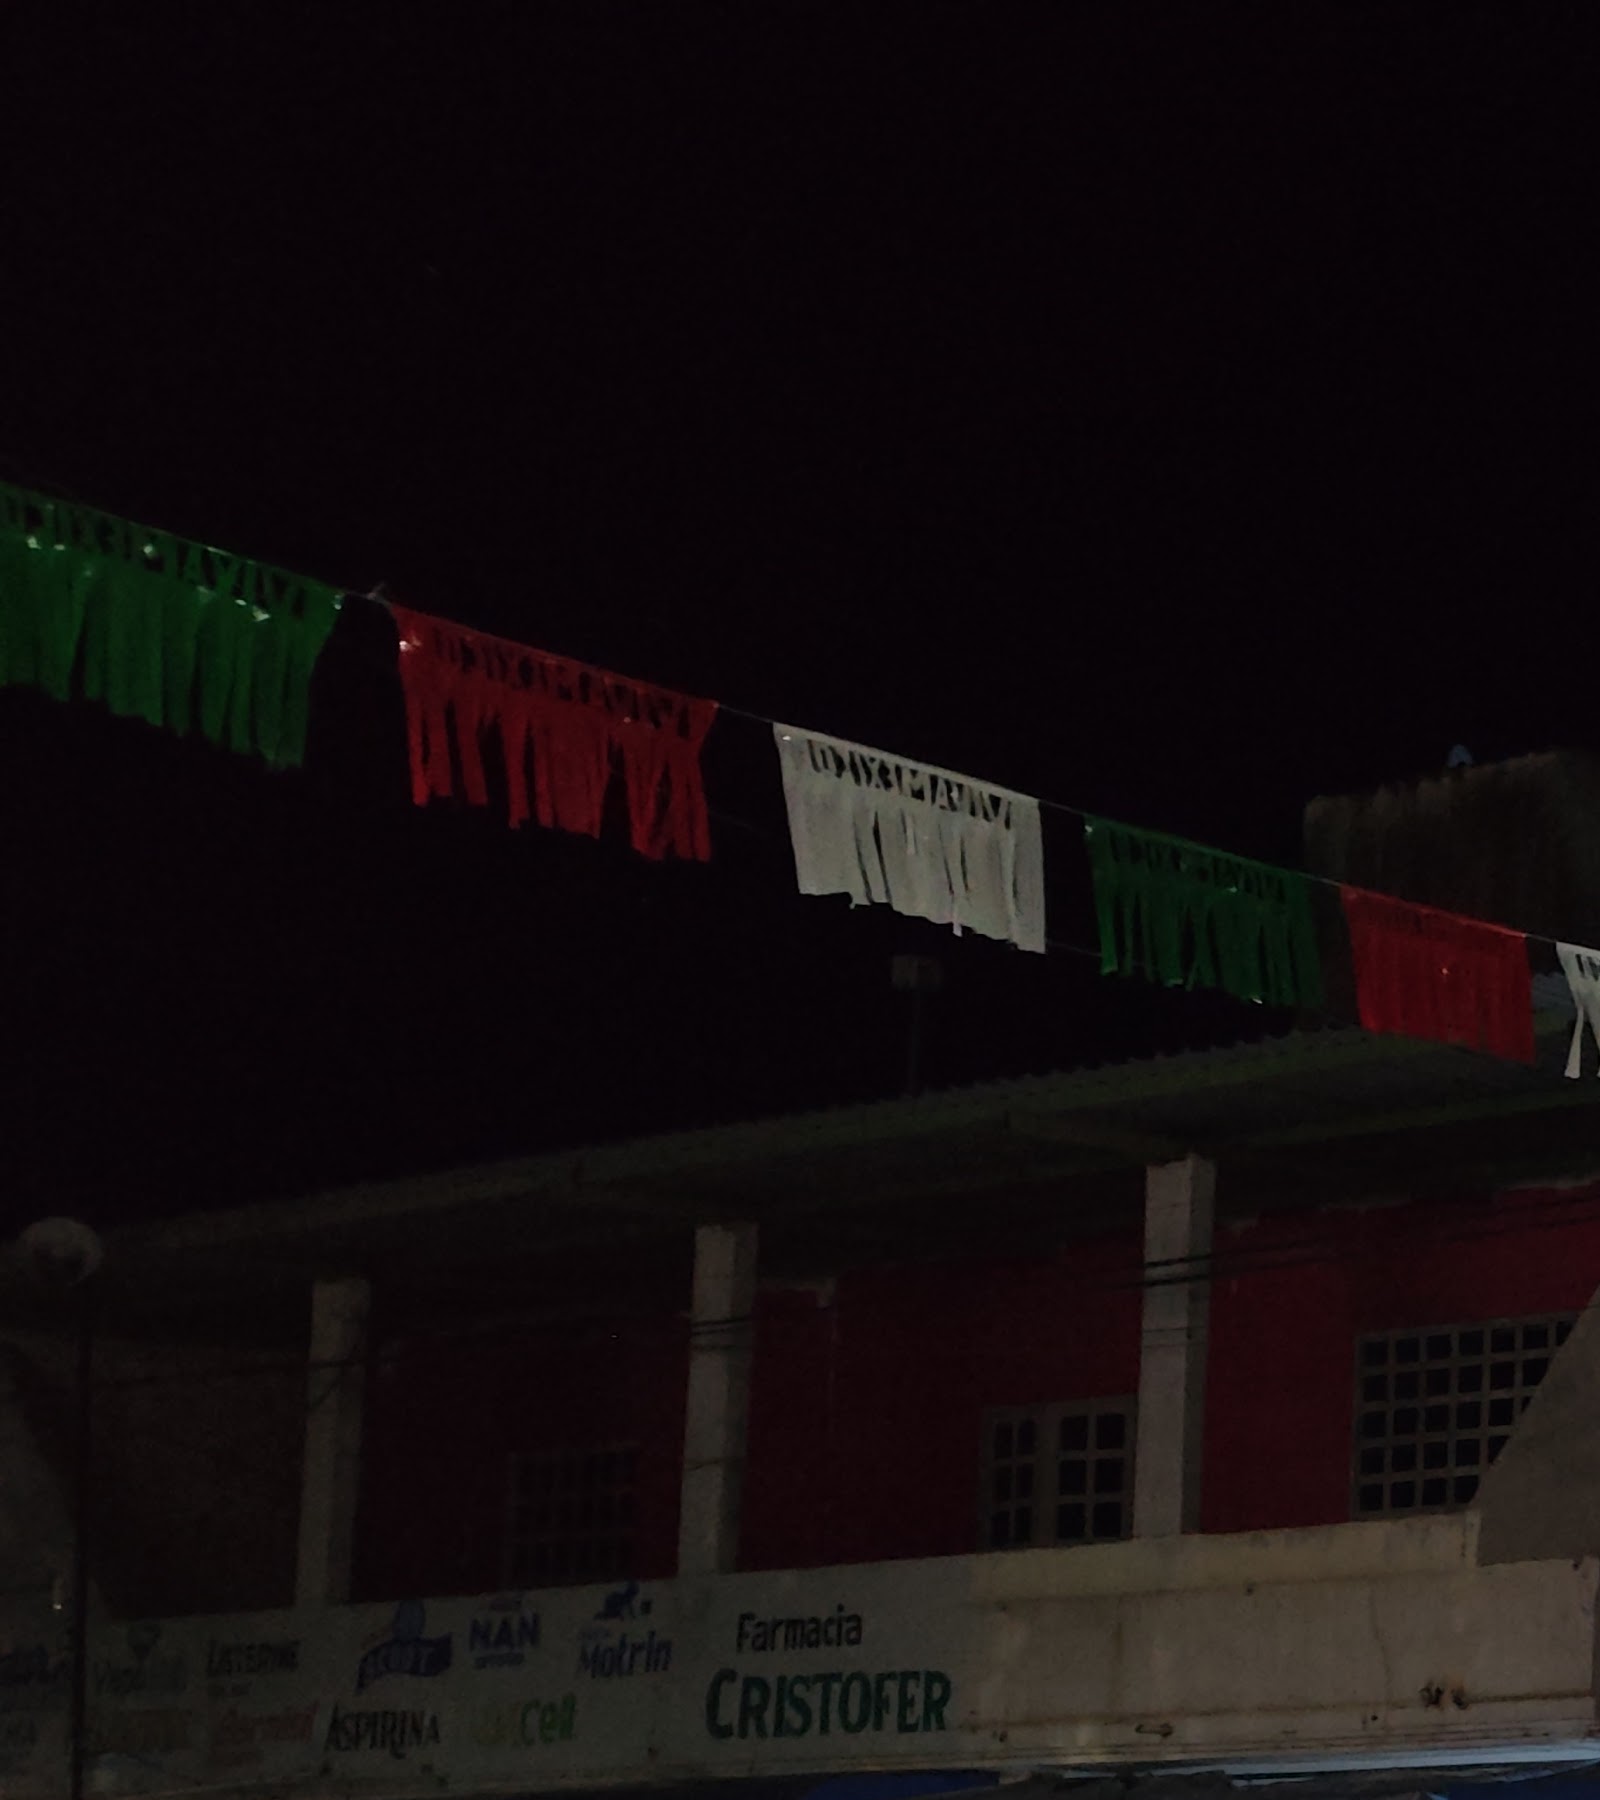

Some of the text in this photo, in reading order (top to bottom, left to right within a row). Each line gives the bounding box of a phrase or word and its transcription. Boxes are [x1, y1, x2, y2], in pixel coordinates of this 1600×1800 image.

[468, 1613, 540, 1654] NAN
[736, 1604, 863, 1654] Farmacia
[325, 1702, 441, 1759] ASPIRINA
[706, 1668, 952, 1740] CRISTOFER
